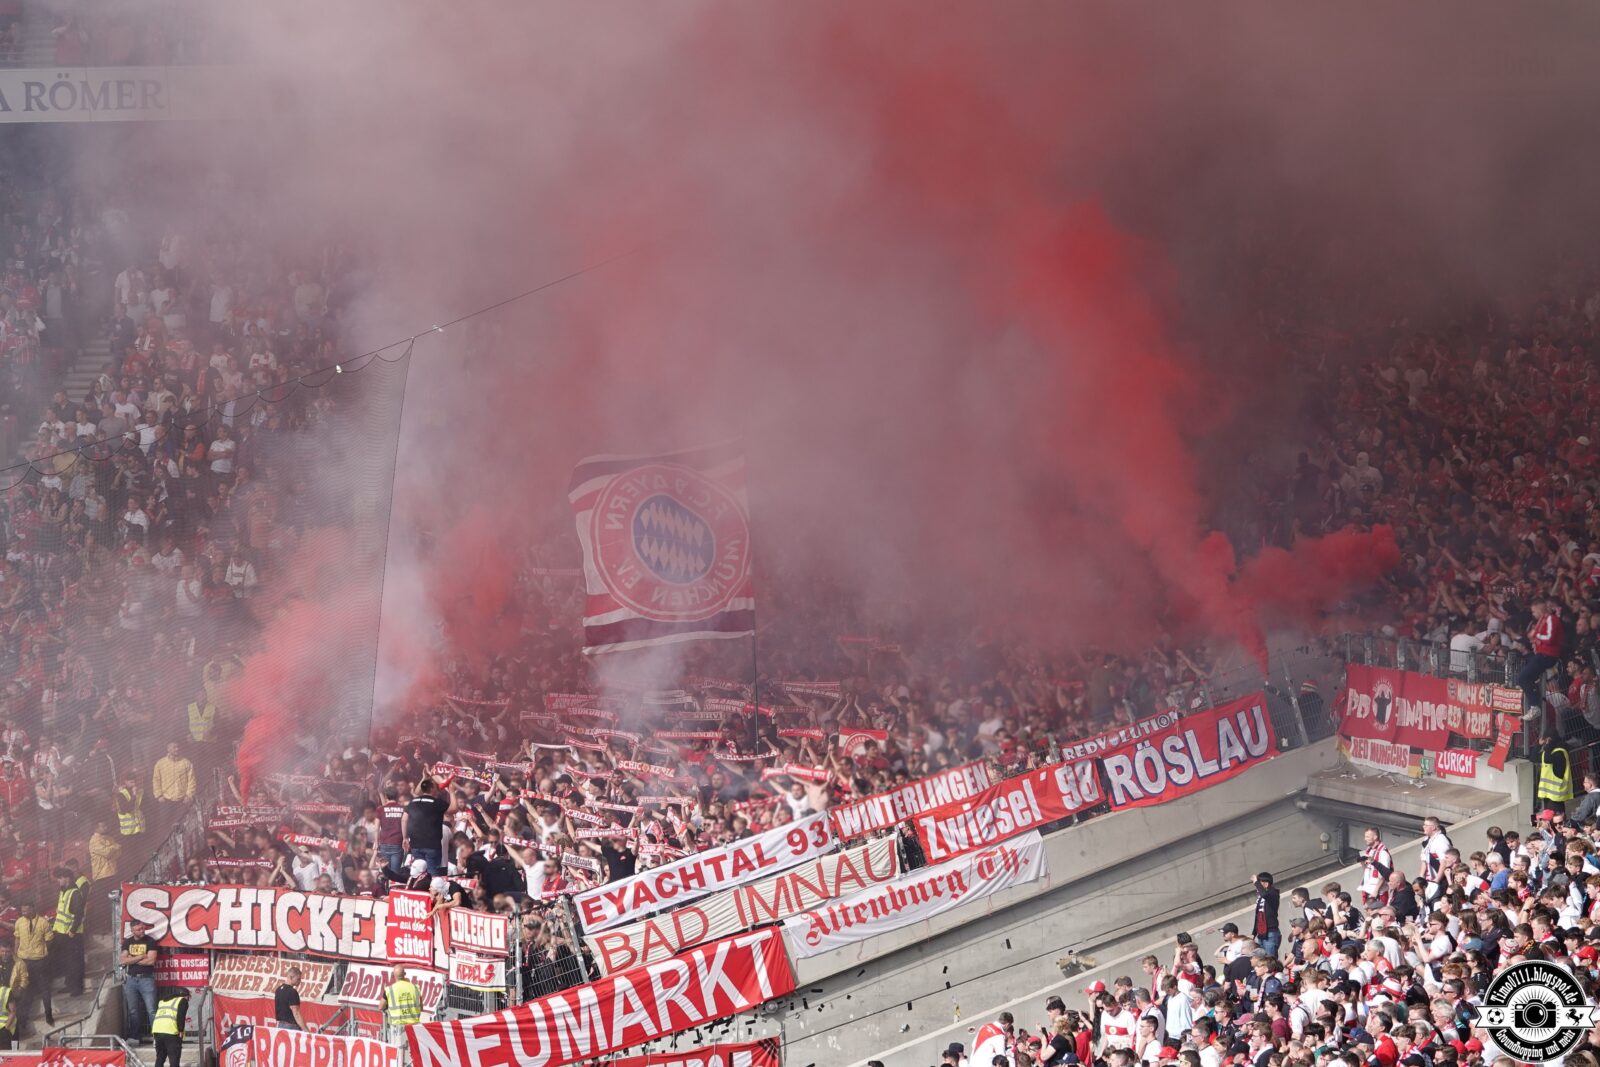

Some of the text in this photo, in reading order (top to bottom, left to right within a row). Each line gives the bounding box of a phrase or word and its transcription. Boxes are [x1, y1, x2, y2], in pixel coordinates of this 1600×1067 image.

[22, 72, 165, 112] RÖMER
[1103, 705, 1269, 806] RÖSLAU
[834, 762, 990, 837] WINTERLINGEN
[579, 817, 830, 926] EYACHTAL 93
[393, 895, 427, 919] ultras
[450, 911, 506, 949] COLEGIO
[594, 833, 898, 974] BAD IMNAU
[804, 867, 969, 947] Altenburg
[165, 957, 179, 967] FÜR
[181, 970, 209, 981] KNAST
[214, 973, 264, 992] IMMER
[414, 940, 774, 1067] NEUMARKT
